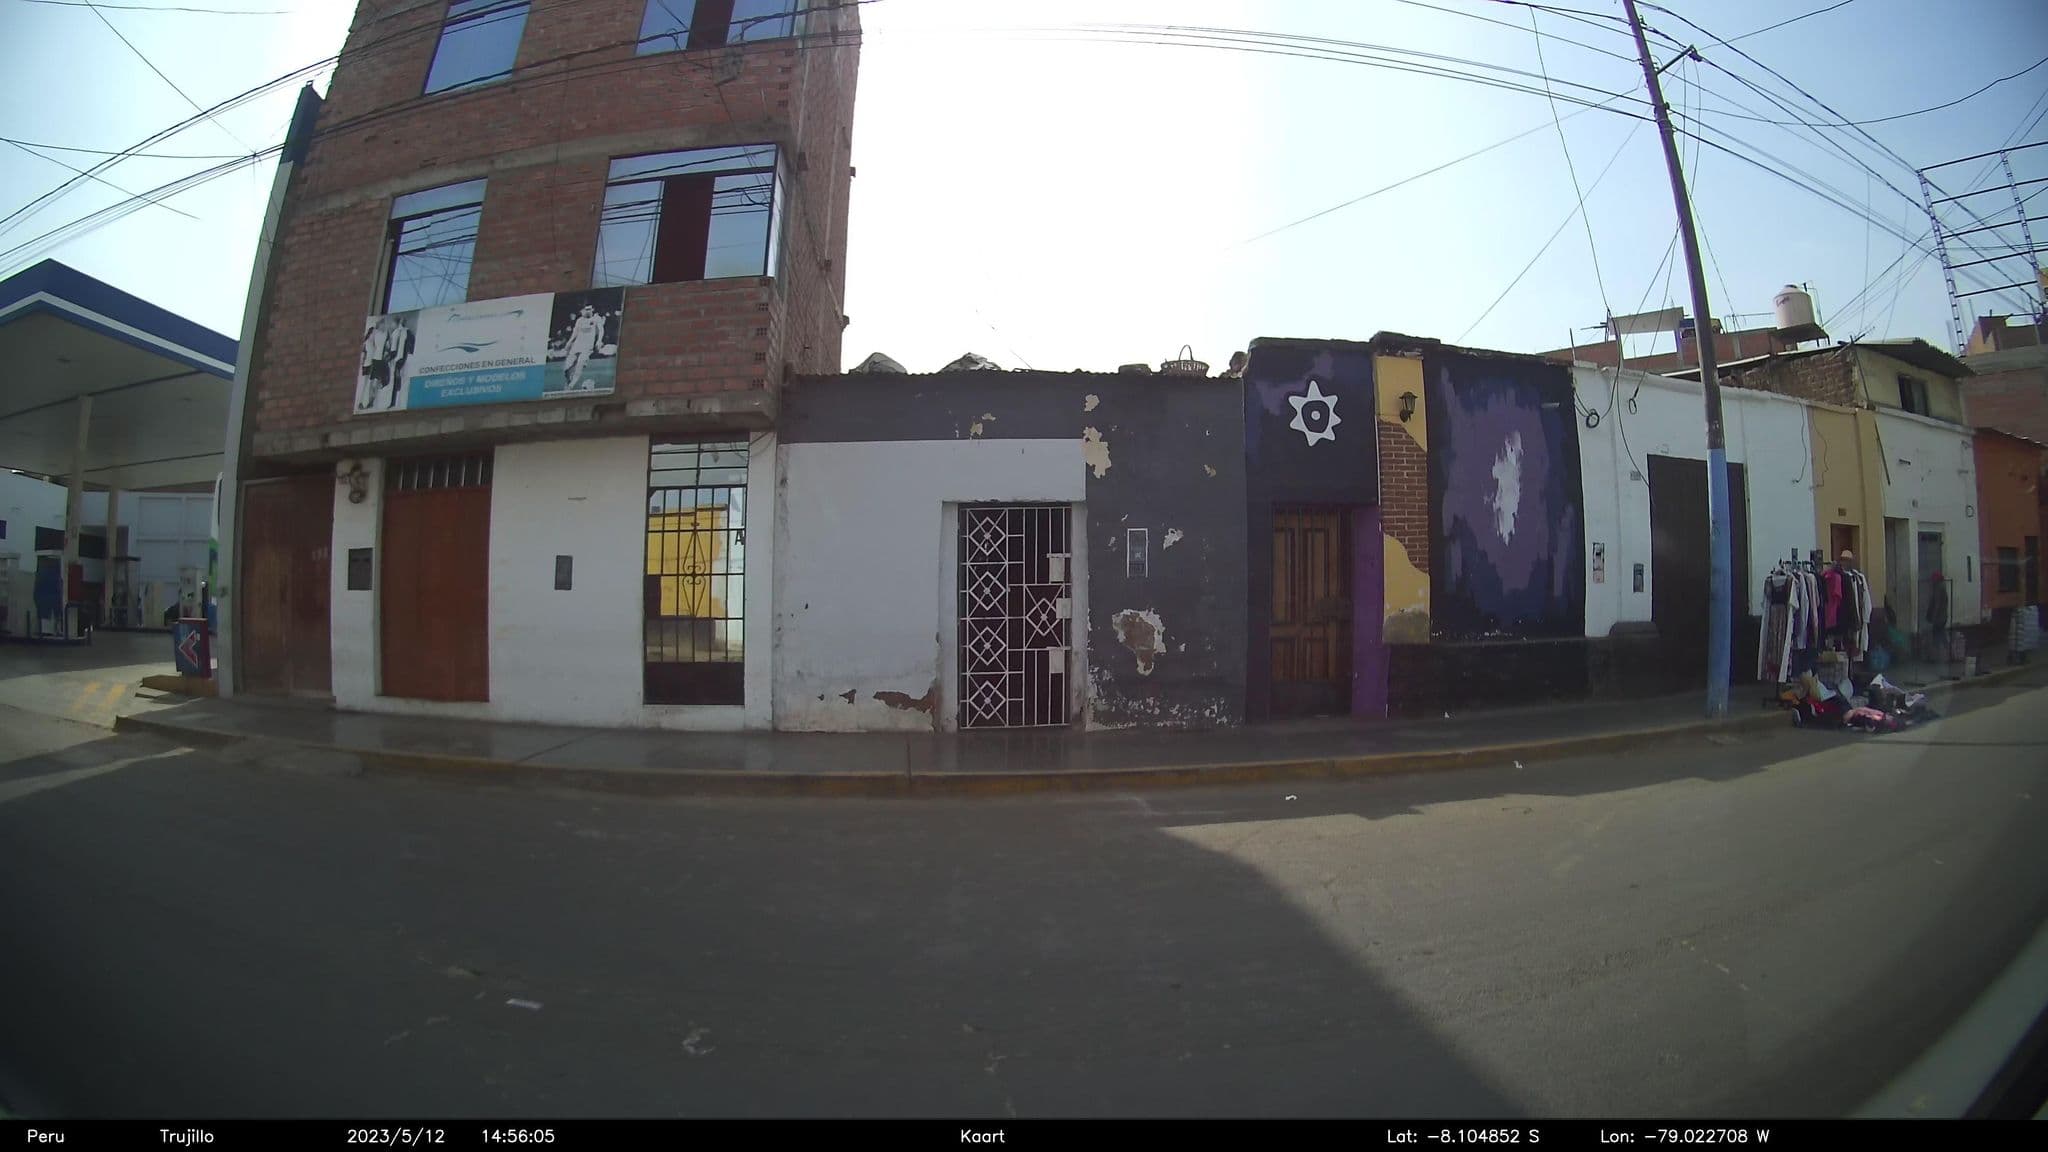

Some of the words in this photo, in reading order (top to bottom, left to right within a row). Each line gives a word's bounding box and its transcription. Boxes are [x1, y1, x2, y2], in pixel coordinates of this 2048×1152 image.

[419, 361, 480, 374] CONFECCIONES
[482, 359, 494, 367] EN
[495, 357, 536, 366] GENERAL
